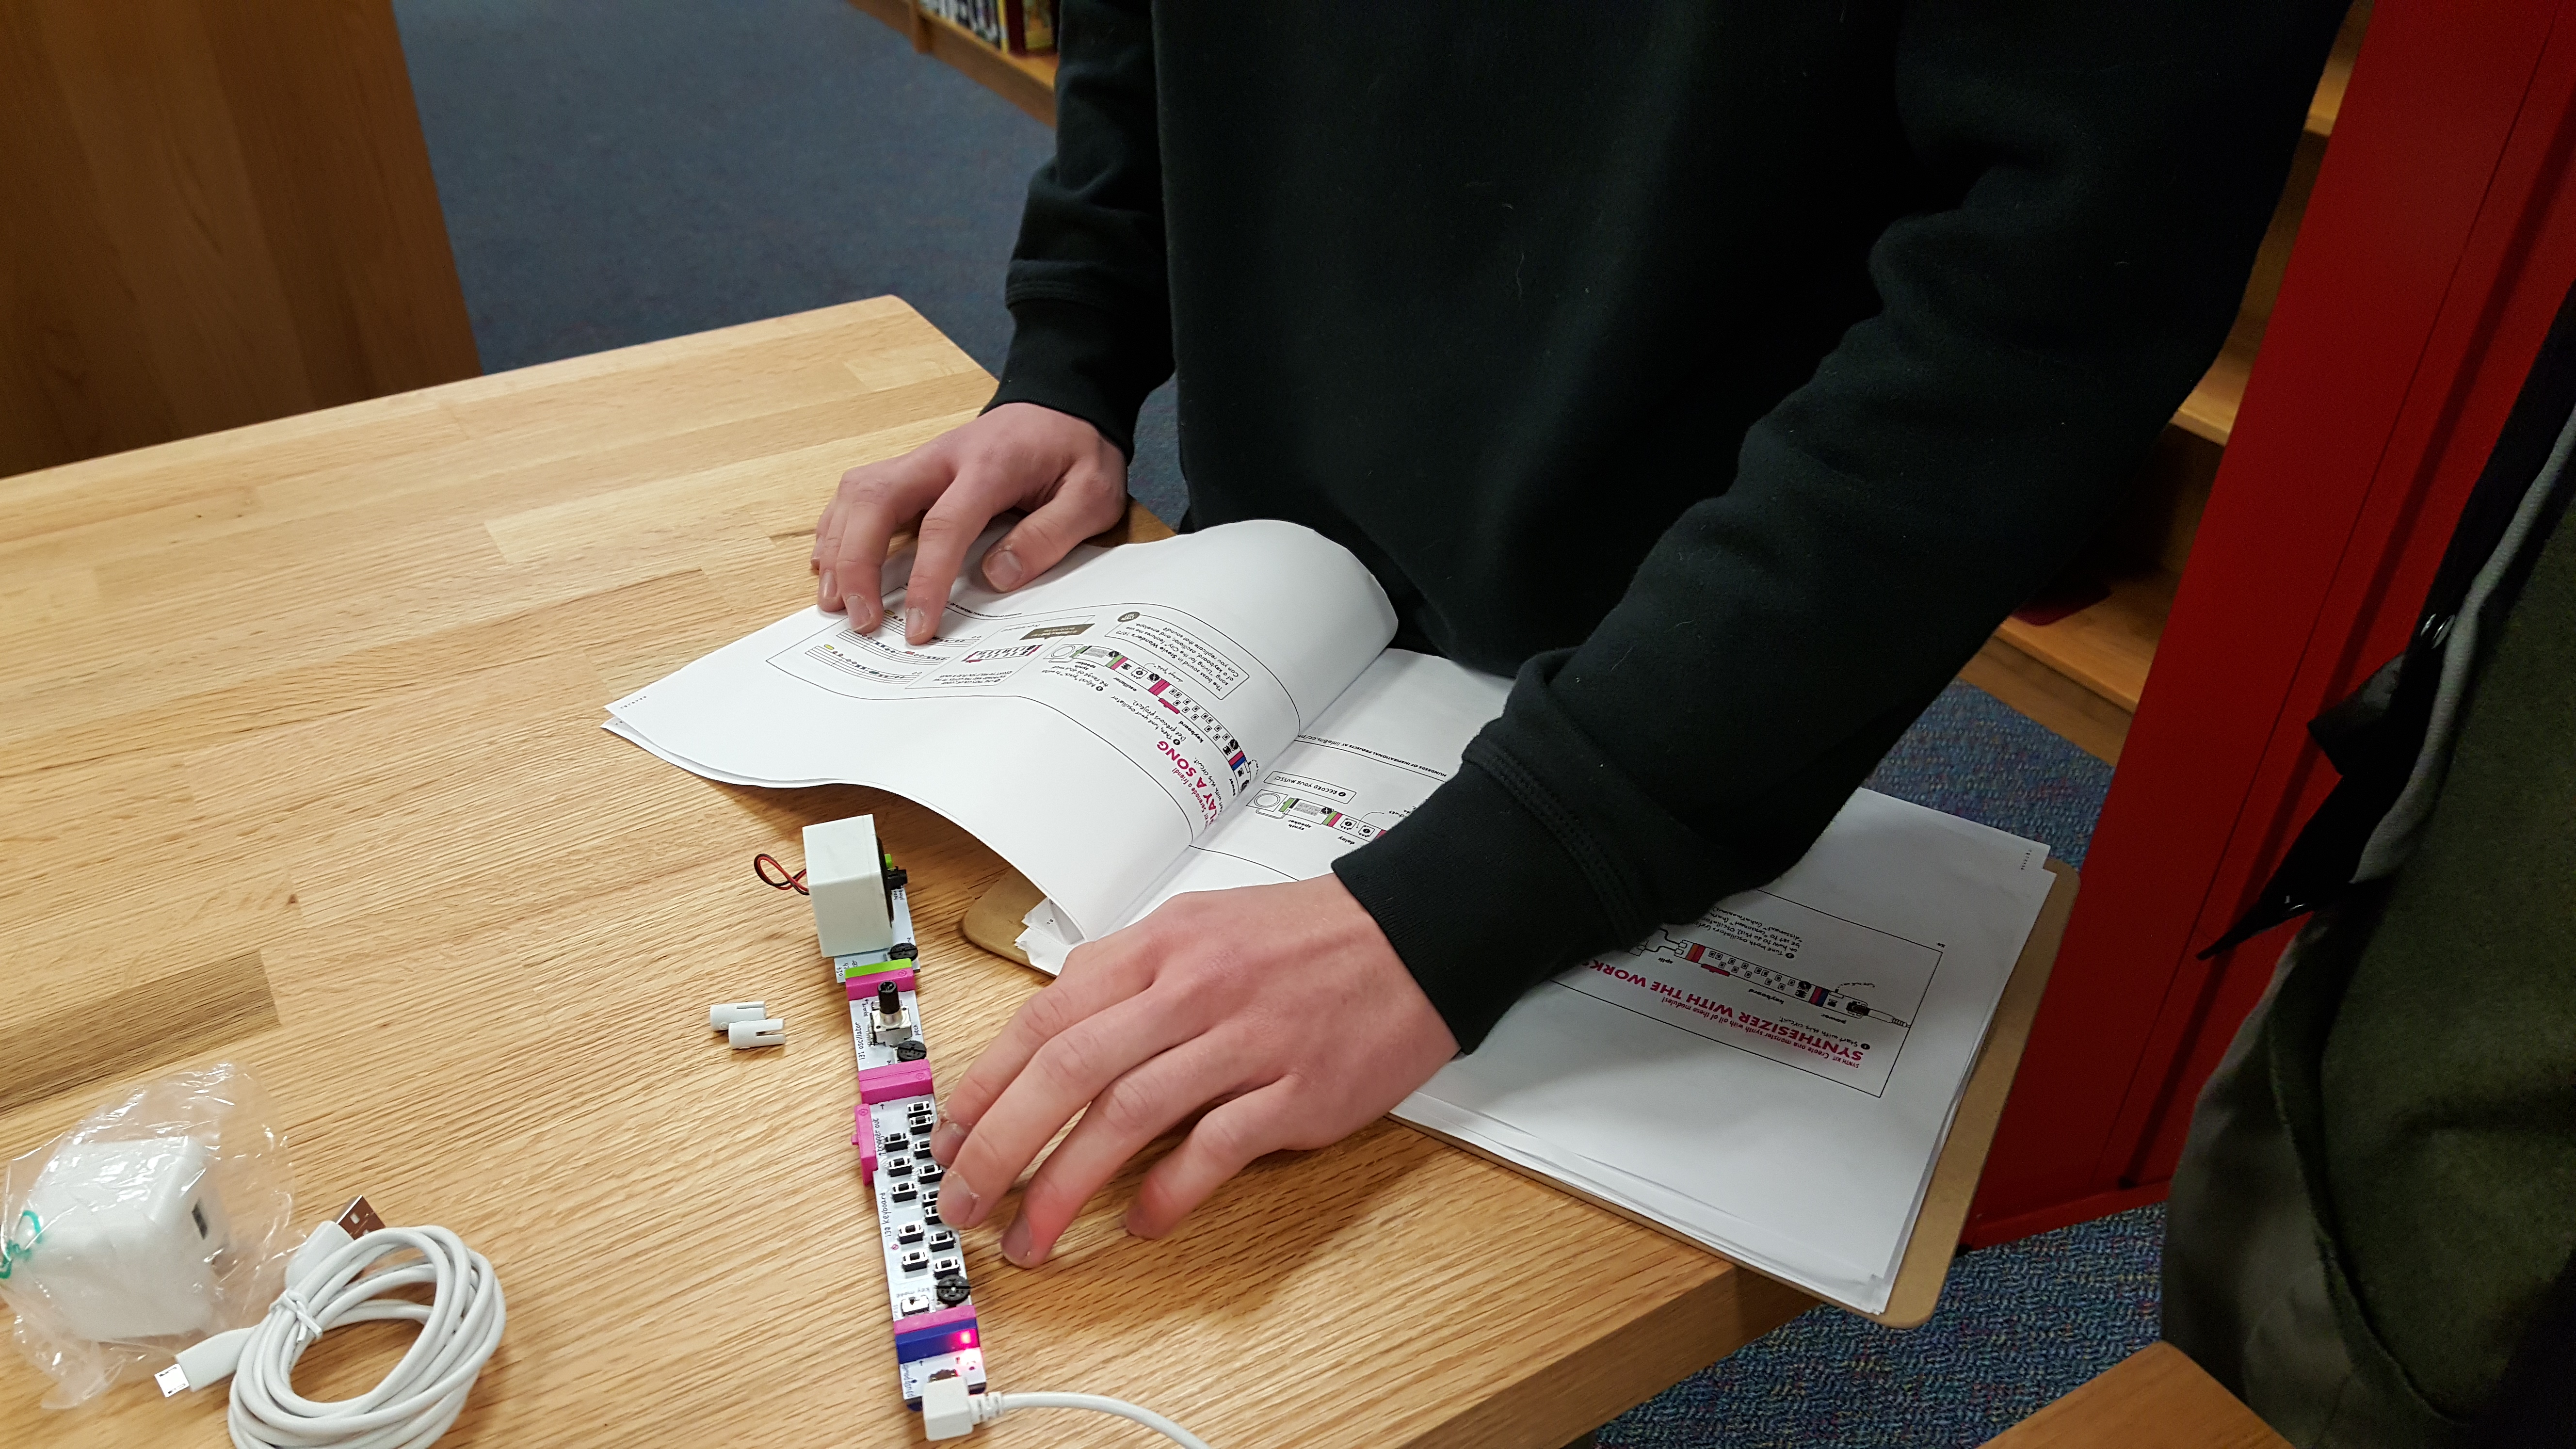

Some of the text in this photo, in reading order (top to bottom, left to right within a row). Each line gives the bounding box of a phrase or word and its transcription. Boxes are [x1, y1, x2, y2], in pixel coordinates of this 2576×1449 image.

[1143, 631, 1165, 644] features
[1183, 637, 1194, 645] that
[1159, 647, 1177, 659] Stevie
[1194, 644, 1217, 660] replicate
[1184, 661, 1200, 673] sound
[1217, 659, 1227, 668] you
[1200, 673, 1213, 683] bass
[1228, 667, 1239, 677] Can
[1215, 675, 1228, 685] song
[1213, 682, 1223, 692] The
[1111, 696, 1135, 712] oscillator
[1147, 719, 1159, 730] tune
[1154, 715, 1177, 732] previous
[1178, 721, 1204, 743] keyboard
[1297, 734, 1340, 746] littleBits.cc/pr
[1349, 744, 1372, 754] PROJECTS
[1157, 741, 1197, 777] SONG
[1372, 751, 1411, 765] INSPIRATIONAL
[1196, 777, 1207, 789] A
[1296, 779, 1312, 788] YOUR
[1313, 784, 1338, 795] RECORD
[1191, 787, 1207, 813] Serenade
[1337, 836, 1355, 845] delay
[1702, 918, 1735, 933] Oscillator
[1749, 940, 1766, 950] both
[1649, 981, 1682, 1000] THE
[1661, 997, 1691, 1011] modules!
[1686, 993, 1733, 1018] WITH
[1692, 1007, 1710, 1018] these
[912, 1024, 920, 1036] pitch
[1729, 1020, 1743, 1029] with
[1805, 1025, 1819, 1033] this
[854, 1022, 864, 1049] oscillator
[1738, 1012, 1863, 1061] SYNTHESIZER
[1745, 1026, 1764, 1036] synth
[1821, 1030, 1839, 1040] with
[1764, 1033, 1792, 1046] monster
[1839, 1037, 1858, 1047] Start
[1807, 1047, 1829, 1059] Create
[1842, 1058, 1859, 1069] SYNTH
[874, 1129, 885, 1152] trigger
[879, 1192, 892, 1224] keyboard
